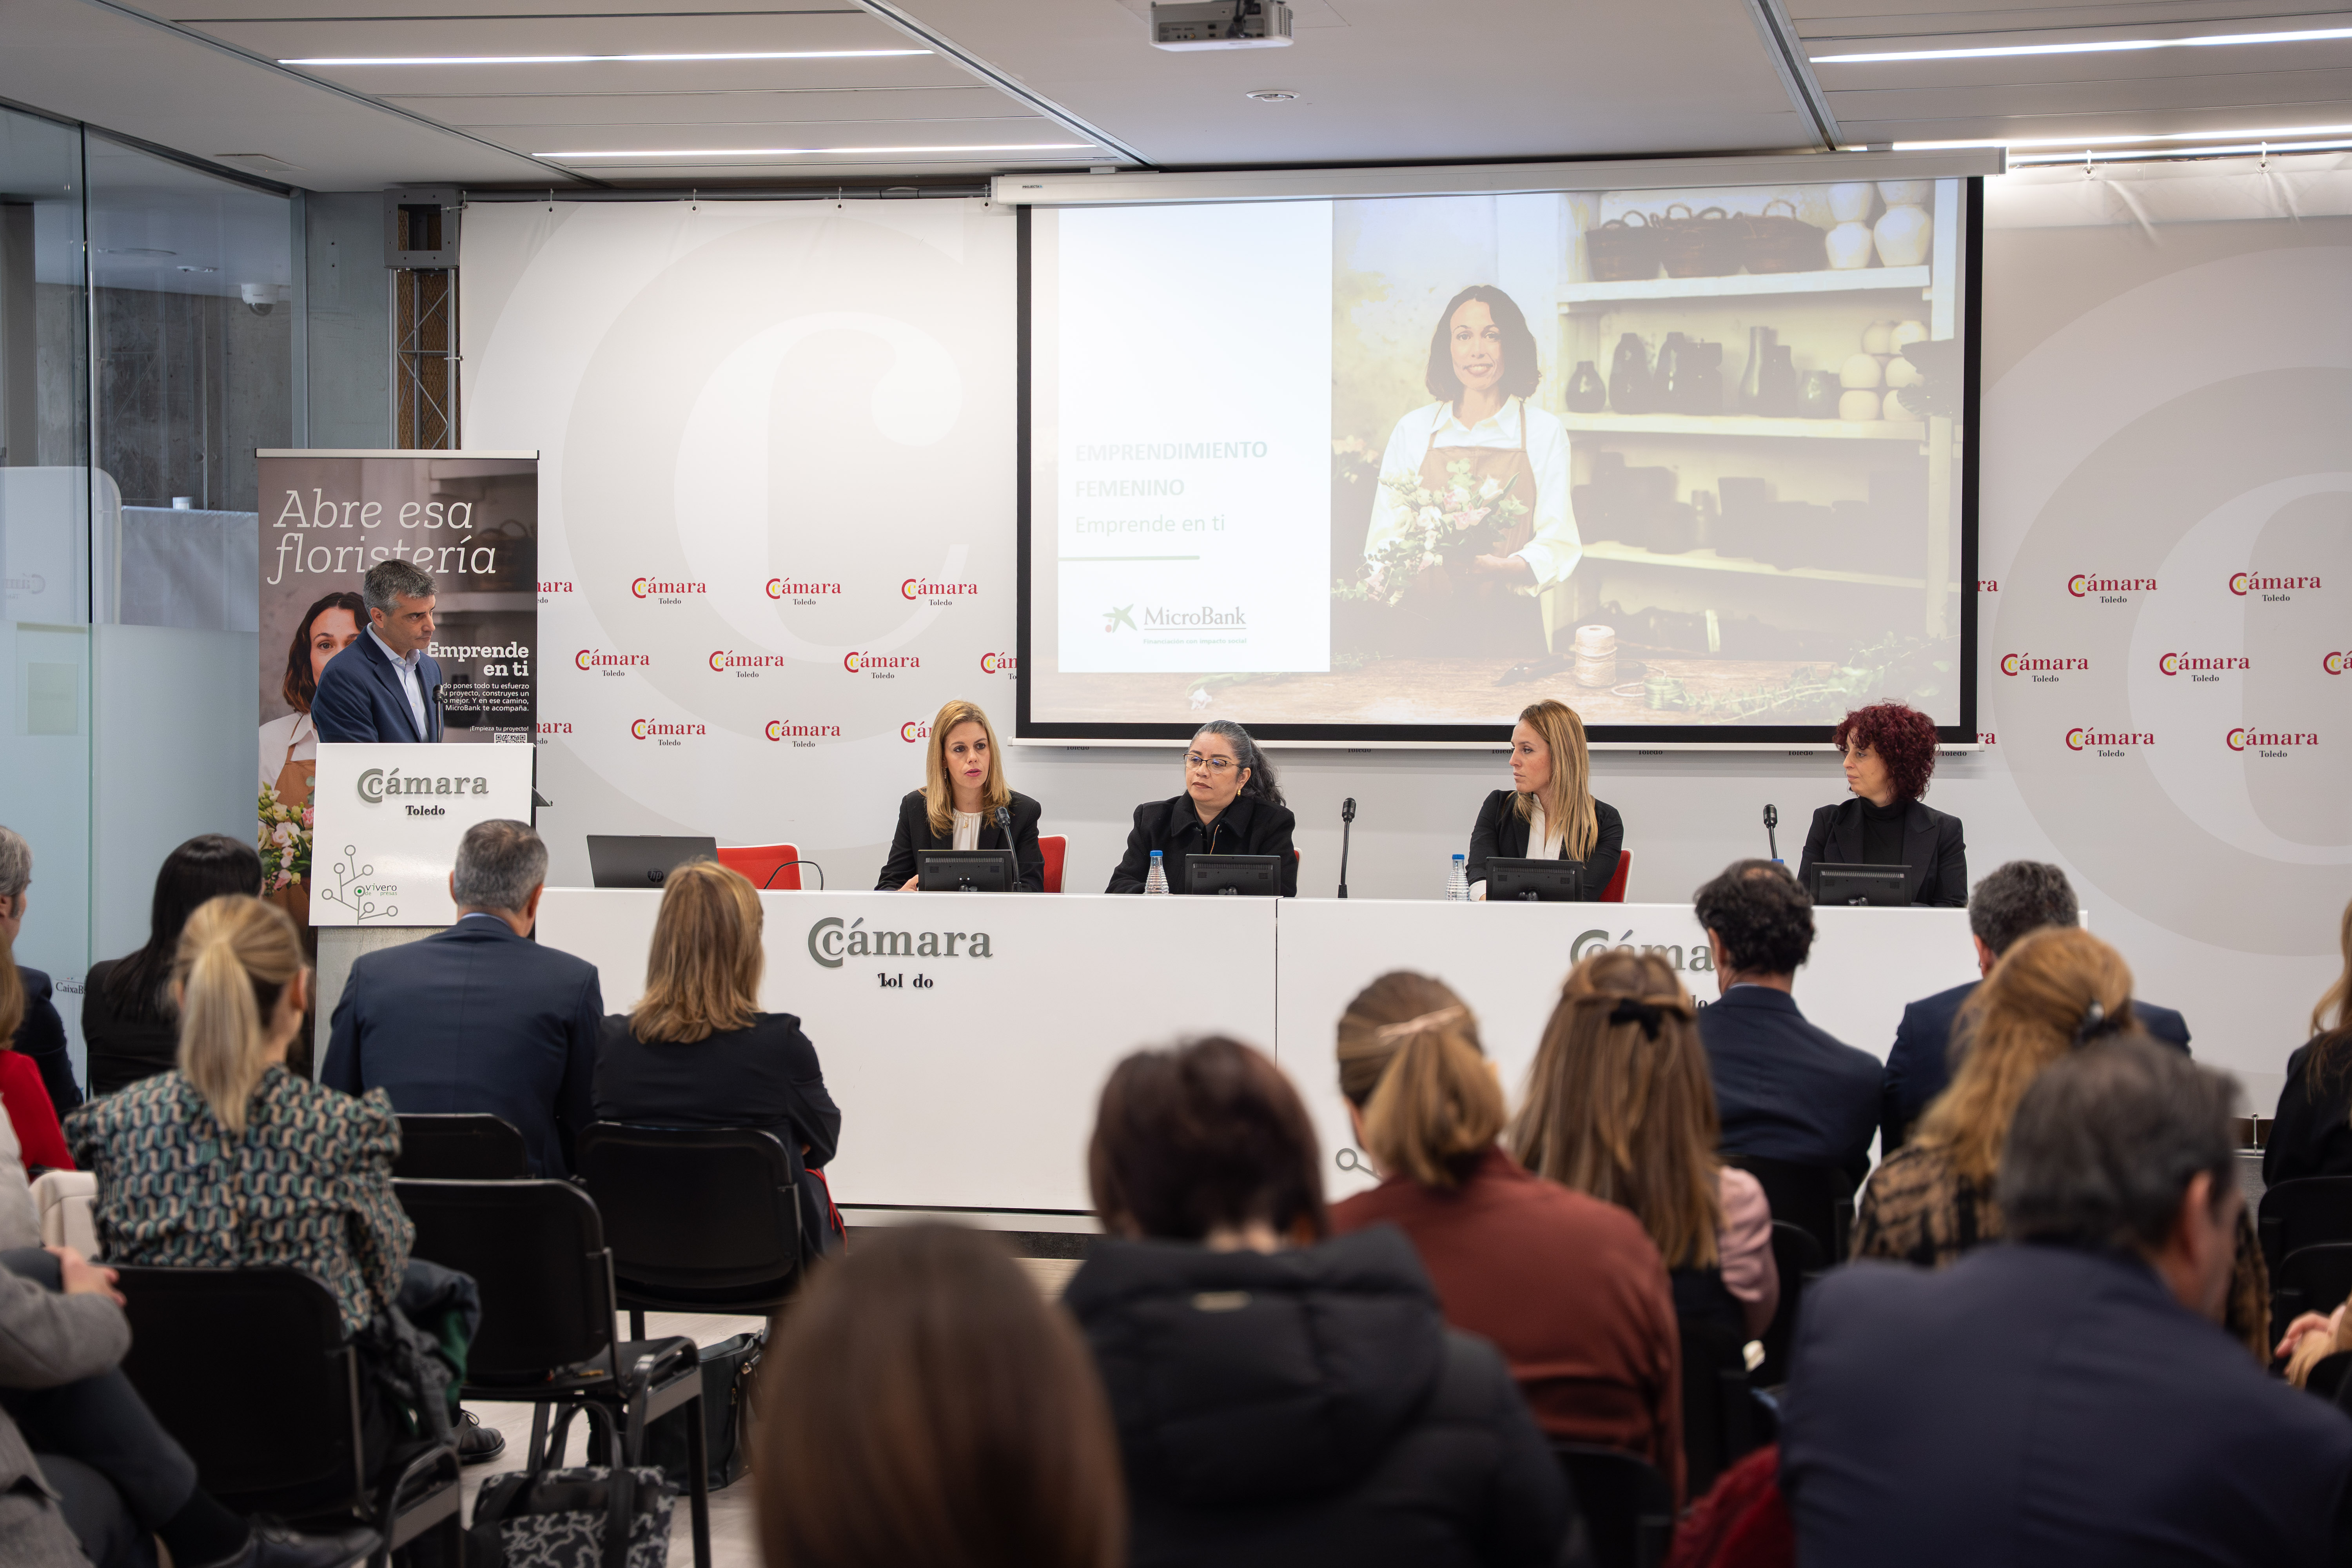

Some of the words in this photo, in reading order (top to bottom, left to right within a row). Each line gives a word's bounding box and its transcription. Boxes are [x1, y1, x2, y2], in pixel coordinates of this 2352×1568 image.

[1075, 441, 1268, 462] EMPRENDIMIENTO
[1075, 479, 1185, 497] FEMENINO
[273, 488, 382, 528] Abre
[399, 502, 472, 529] esa
[1076, 514, 1175, 537] Emprende
[1182, 518, 1205, 532] en
[1212, 514, 1225, 531] ti
[537, 582, 573, 592] ara
[632, 577, 706, 599] Cámara
[766, 578, 841, 599] Cámara
[902, 578, 978, 600] Cámara
[2068, 574, 2157, 597] Cámara
[2229, 572, 2321, 596] Cámara
[1143, 606, 1247, 625] MicroBank
[427, 641, 529, 662] Emprende
[575, 649, 650, 670] Cámara
[709, 650, 784, 672] Cámara
[844, 651, 920, 673] Cámara
[483, 664, 508, 676] en
[512, 660, 529, 676] ti
[2001, 653, 2089, 676] Cámara
[2160, 652, 2250, 676] Cámara
[537, 723, 572, 733] ara
[632, 719, 706, 740] Cámara
[765, 720, 841, 741] Cámara
[2227, 727, 2319, 751] Cámara
[2066, 728, 2155, 751] Cámara
[358, 768, 489, 803] Cámara
[405, 805, 445, 815] Toledo
[365, 883, 397, 891] vivero
[808, 917, 993, 967] Cámara
